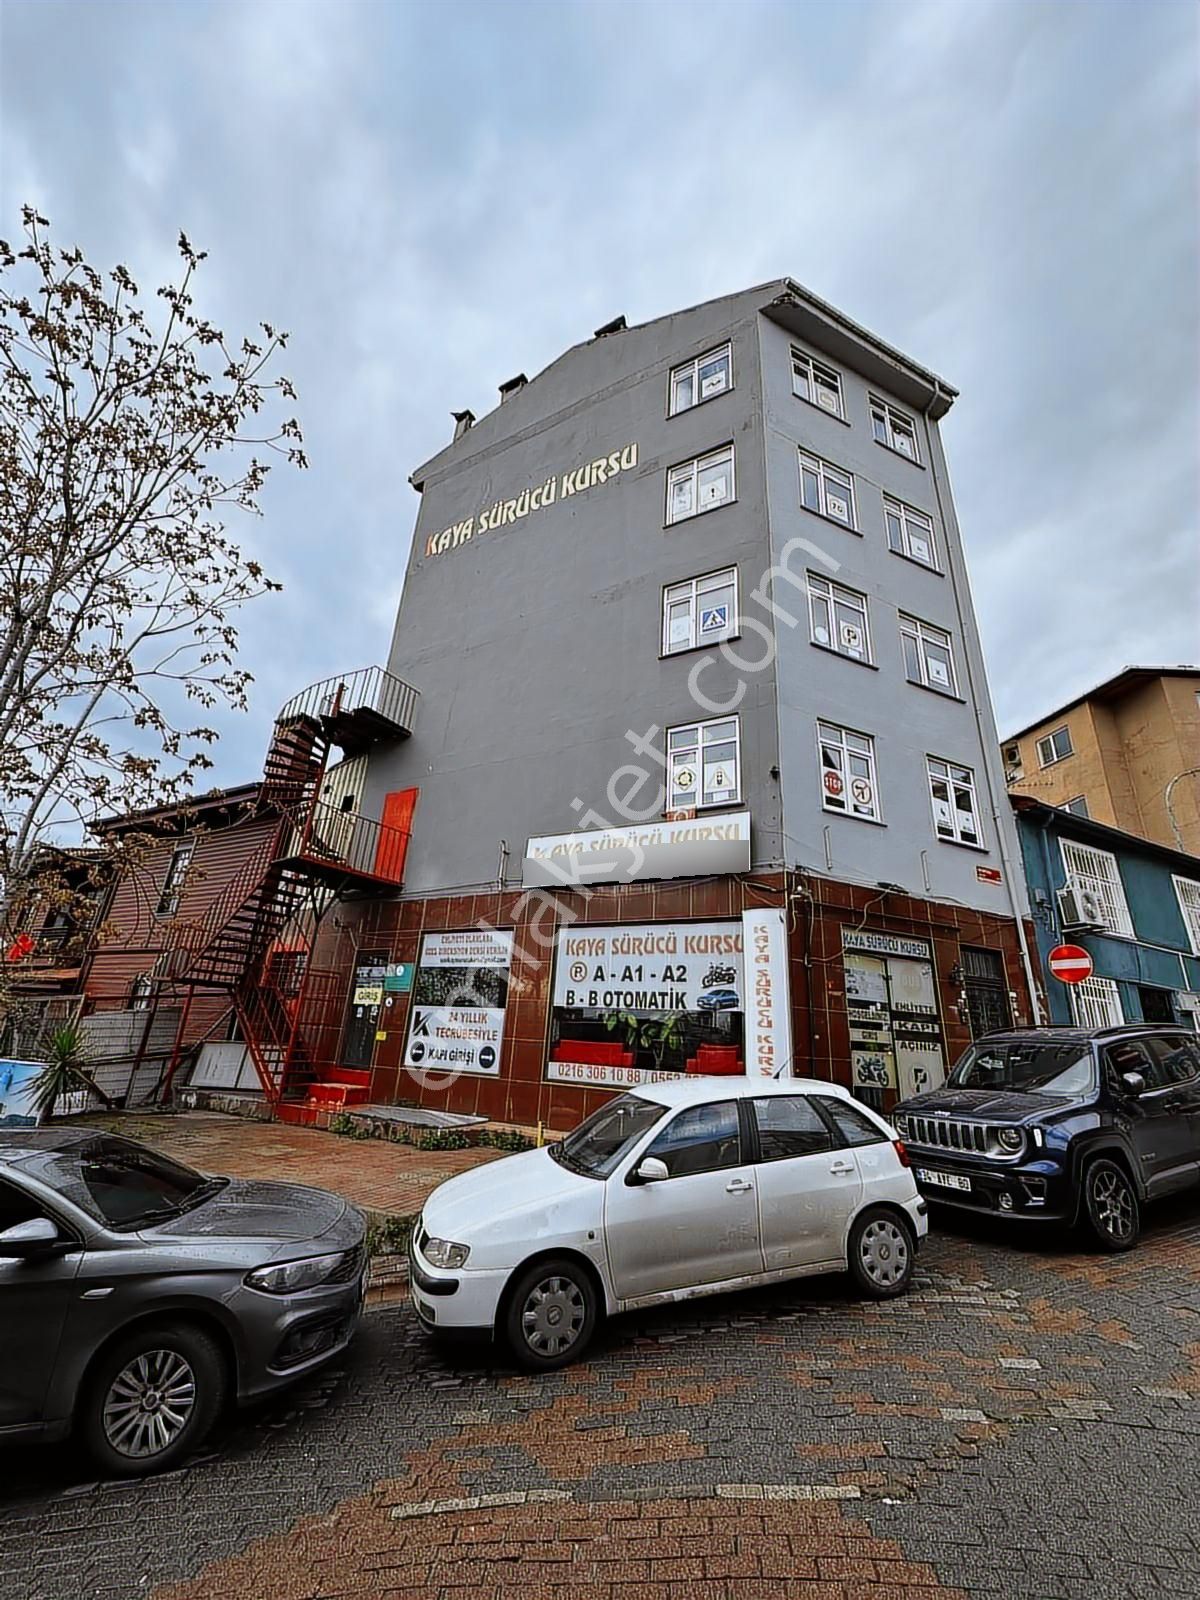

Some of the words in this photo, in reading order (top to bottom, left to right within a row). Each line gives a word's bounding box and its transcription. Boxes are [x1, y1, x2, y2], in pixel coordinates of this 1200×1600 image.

[426, 517, 474, 557] KAYA
[478, 476, 558, 535] SÜRÜCÜ
[560, 442, 638, 499] KURSU
[566, 938, 606, 957] KAYA
[611, 931, 677, 956] SÜRÜCÜ
[754, 926, 769, 964] KAYA
[843, 932, 865, 947] KAYA
[866, 935, 898, 951] SÜRÜCÜ
[900, 941, 928, 956] KURSU
[593, 965, 605, 982] A
[621, 965, 643, 982] A1
[662, 965, 687, 982] A2
[567, 990, 575, 1006] B
[588, 990, 598, 1007] B
[603, 987, 687, 1009] OTOMATİK
[460, 1012, 488, 1024] YILLIK
[428, 1048, 447, 1061] KAPI
[449, 1047, 475, 1065] GİRİŞİ
[558, 1063, 583, 1078] 0216
[587, 1066, 606, 1080] 306
[611, 1068, 623, 1081] 10
[627, 1069, 640, 1083] 88
